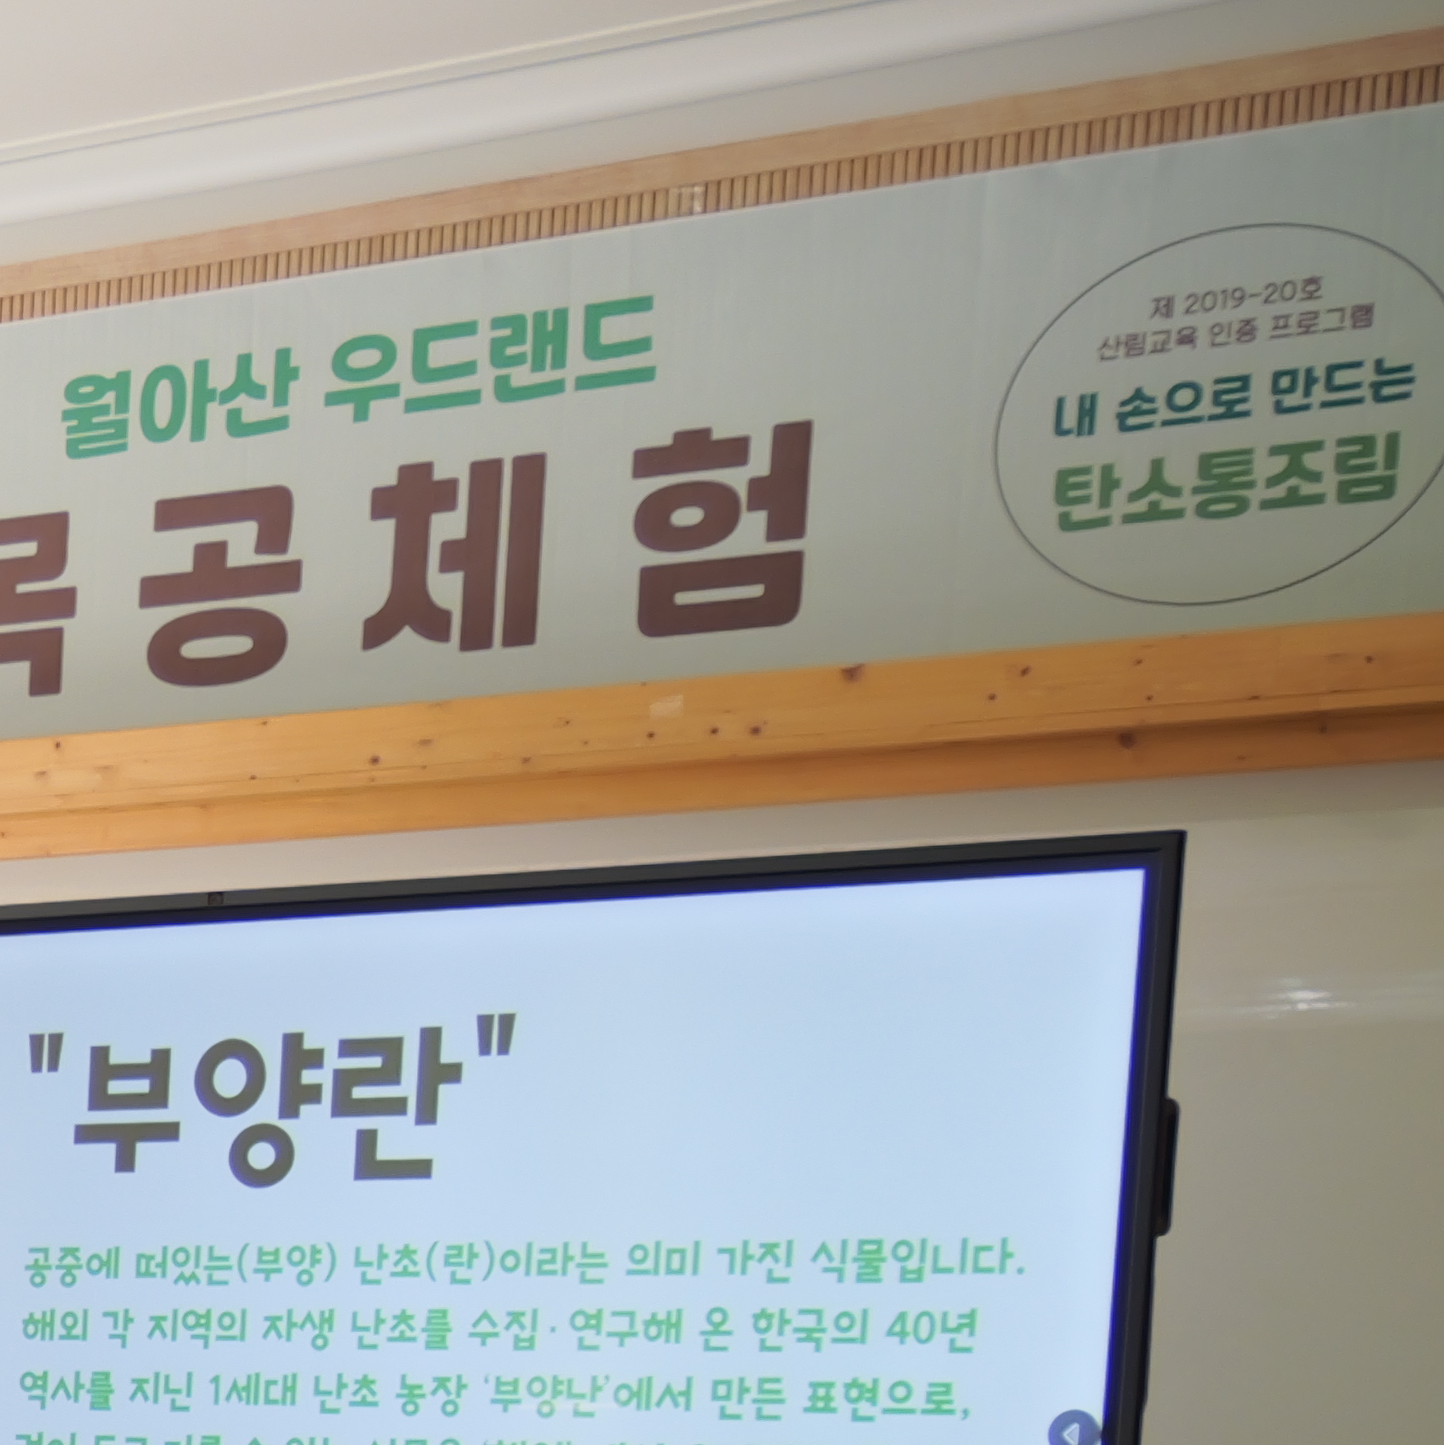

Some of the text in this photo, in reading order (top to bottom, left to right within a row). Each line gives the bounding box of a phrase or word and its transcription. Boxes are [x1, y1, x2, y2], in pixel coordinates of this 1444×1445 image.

[1148, 275, 1324, 320] 제 2019-20호
[1097, 302, 1376, 362] 산림교육 인증 프로그램
[61, 294, 657, 460] 월아산 우드랜드
[1053, 357, 1417, 437] 내 손으로 만드는
[1053, 430, 1402, 532] 탄소통조림
[25, 1246, 120, 1288] 공중에
[354, 1241, 608, 1285] 난초(란)이라는
[626, 1241, 700, 1275] 의미
[718, 1240, 793, 1283] 가진
[811, 1237, 1024, 1283] 식물입니다.
[23, 1309, 88, 1341] 해외
[102, 1309, 134, 1348] 각
[148, 1309, 246, 1349] 지역의
[263, 1309, 334, 1351] 자생
[352, 1309, 452, 1350] 난초를
[700, 1307, 733, 1351] 온
[753, 1308, 868, 1352] 한국의
[886, 1308, 977, 1353] 40년
[20, 1371, 114, 1411] 역사를
[129, 1372, 193, 1412] 지닌
[210, 1373, 297, 1406] 1세대
[314, 1373, 379, 1414] 난초
[396, 1374, 468, 1417] 농장
[712, 1377, 785, 1421] 만든
[803, 1377, 969, 1422] 표현으로,
